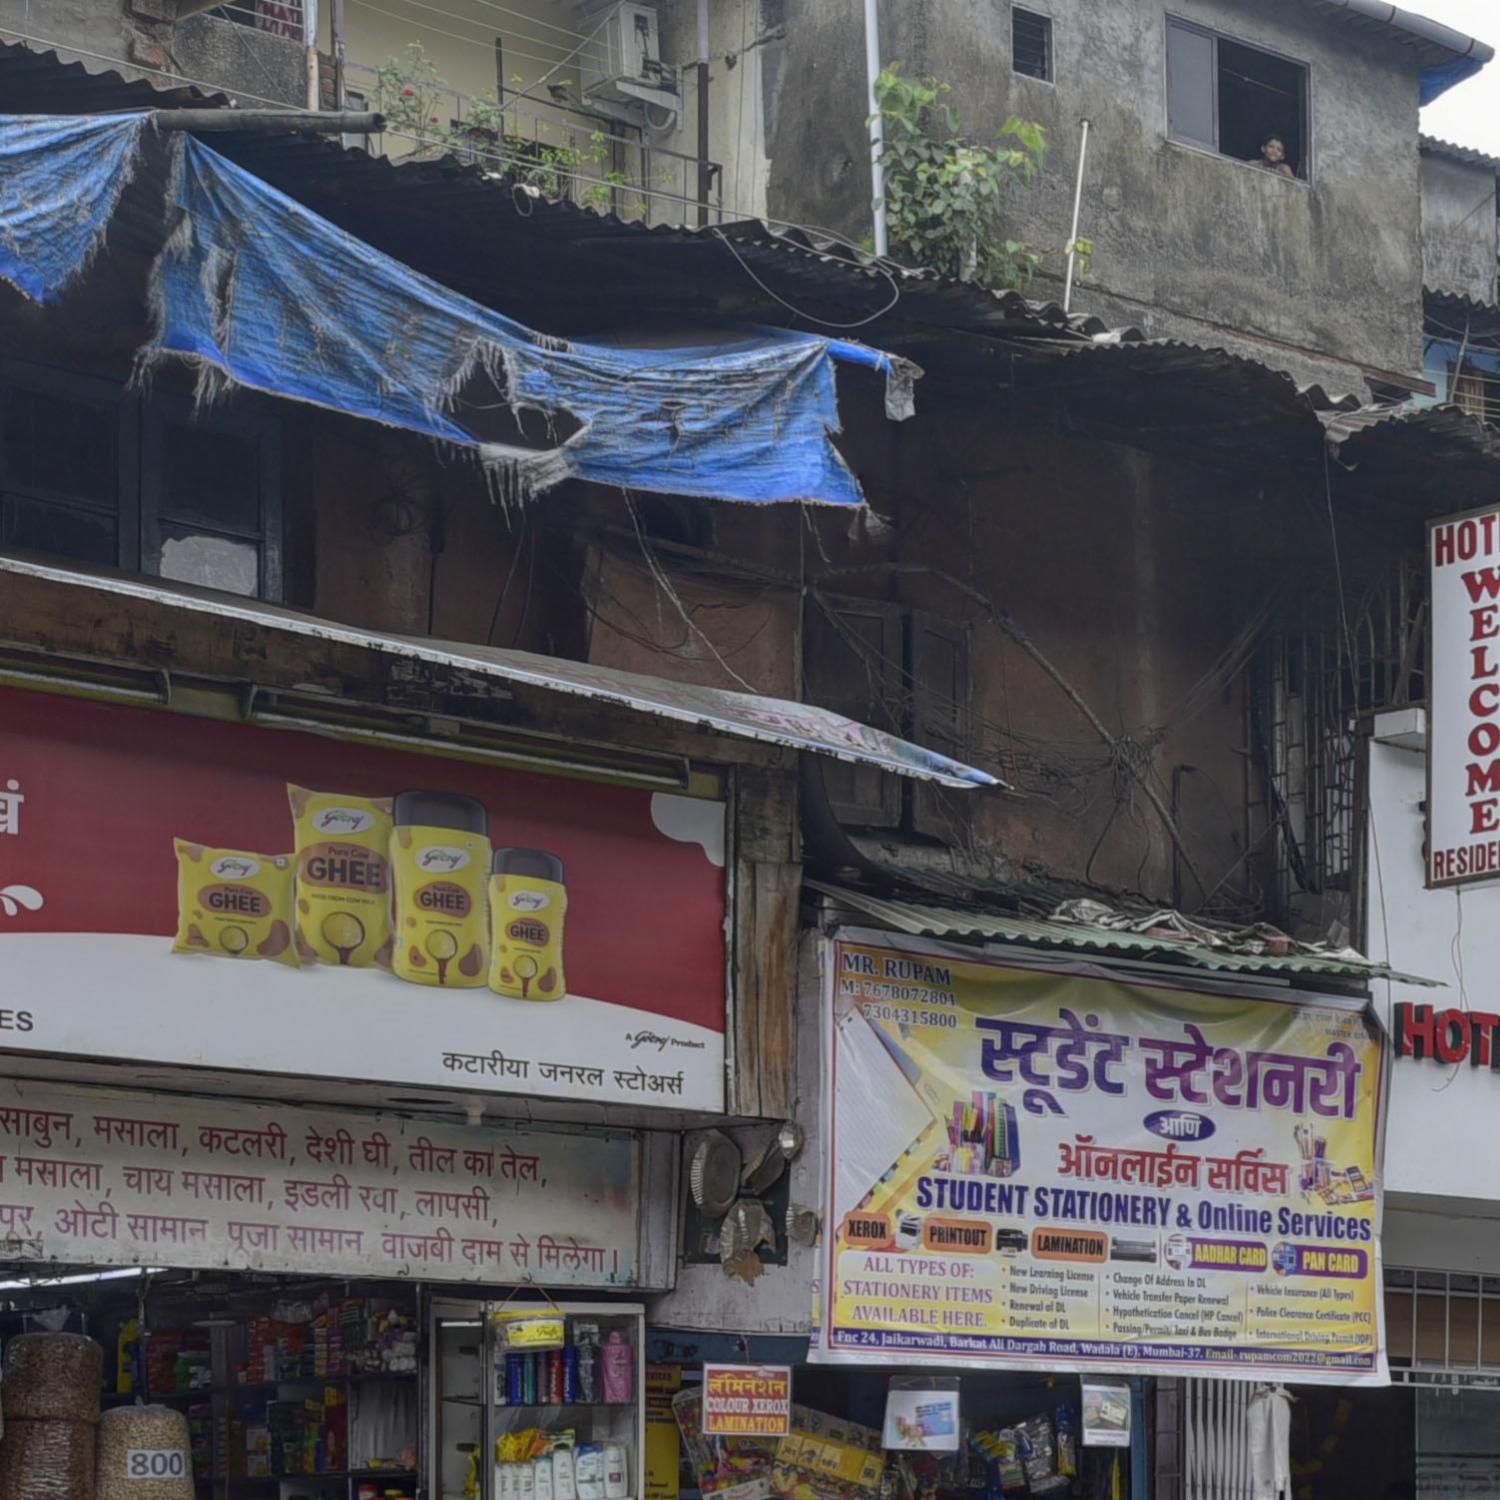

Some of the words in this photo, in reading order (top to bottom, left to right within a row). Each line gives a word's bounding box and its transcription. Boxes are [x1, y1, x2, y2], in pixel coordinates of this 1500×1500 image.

[307, 859, 381, 887] GHEE
[208, 892, 261, 912] GHEE
[420, 891, 465, 911] GHEE
[510, 925, 545, 941] GHEE
[843, 953, 878, 975] MR.
[885, 959, 951, 985] RUPAM
[841, 980, 860, 994] M:
[864, 982, 956, 1006] 7678072801
[625, 1033, 632, 1041] A
[671, 1039, 705, 1049] Product
[442, 1050, 530, 1079] कटारीया
[539, 1061, 604, 1087] जनरल
[613, 1066, 684, 1095] स्टोअर्स
[975, 1007, 1129, 1116] स्टूडेंट
[1139, 1024, 1363, 1120] स्टेशनरी
[1159, 1114, 1202, 1138] आणि
[306, 1126, 354, 1165] देशी
[408, 1136, 457, 1174] तील
[464, 1149, 494, 1177] का
[1057, 1133, 1203, 1190] ऑनलाईन
[1207, 1147, 1289, 1195] सर्विस
[122, 1166, 175, 1196] चाय
[284, 1173, 351, 1211] इडली
[917, 1176, 1029, 1215] STUDENT
[1034, 1186, 1171, 1226] STATIONERY
[1176, 1203, 1192, 1228] &
[1198, 1200, 1272, 1234] Online
[1278, 1206, 1371, 1241] Services
[54, 1200, 120, 1239] ओटी
[126, 1213, 209, 1243] सामान
[228, 1221, 280, 1251] पूजा
[287, 1224, 363, 1256] सामान
[462, 1237, 503, 1266] दाम
[510, 1233, 530, 1268] से
[848, 1219, 887, 1239] XEROX
[929, 1227, 987, 1247] PRINTOUT
[1037, 1234, 1103, 1256] LAMINATION
[1194, 1243, 1236, 1265] AADHAR
[1239, 1245, 1267, 1267] CARD
[863, 1256, 893, 1273] ALL
[898, 1258, 947, 1277] TYPES
[950, 1262, 974, 1279] OF:
[1302, 1251, 1327, 1272] PAN
[1329, 1253, 1359, 1274] CARD
[1009, 1266, 1027, 1277] New
[1030, 1267, 1065, 1281] Learning
[1067, 1269, 1094, 1282] License
[1113, 1273, 1142, 1287] Change
[1155, 1274, 1185, 1288] Address
[843, 1280, 942, 1300] STATIONERY
[945, 1286, 993, 1304] ITEMS
[1009, 1283, 1027, 1294] New
[1029, 1284, 1058, 1299] Driving
[1060, 1286, 1089, 1298] License
[1113, 1289, 1141, 1302] Vehicle
[1142, 1291, 1172, 1304] Transfer
[1174, 1293, 1196, 1306] Paper
[1197, 1294, 1229, 1306] Renewal
[1257, 1285, 1282, 1296] Vehicle
[1284, 1287, 1318, 1298] Insurance
[1009, 1300, 1043, 1312] Renewal
[1256, 1306, 1277, 1317] Police
[852, 1305, 939, 1325] AVAILABLE
[943, 1310, 987, 1328] HERE.
[1009, 1316, 1047, 1330] Duplicate
[1174, 1308, 1199, 1321] Cancel
[1216, 1311, 1243, 1325] Cancel)
[1213, 1327, 1237, 1339] Badge
[949, 1337, 988, 1350] Barkat
[989, 1338, 1005, 1350] Ali
[1007, 1341, 1047, 1354] Dargah
[1082, 1343, 1121, 1356] Wadala
[706, 1399, 749, 1414] COLOUR
[752, 1399, 787, 1415] XEROX
[708, 1416, 785, 1431] LAMINATION
[131, 1452, 183, 1476] 800
